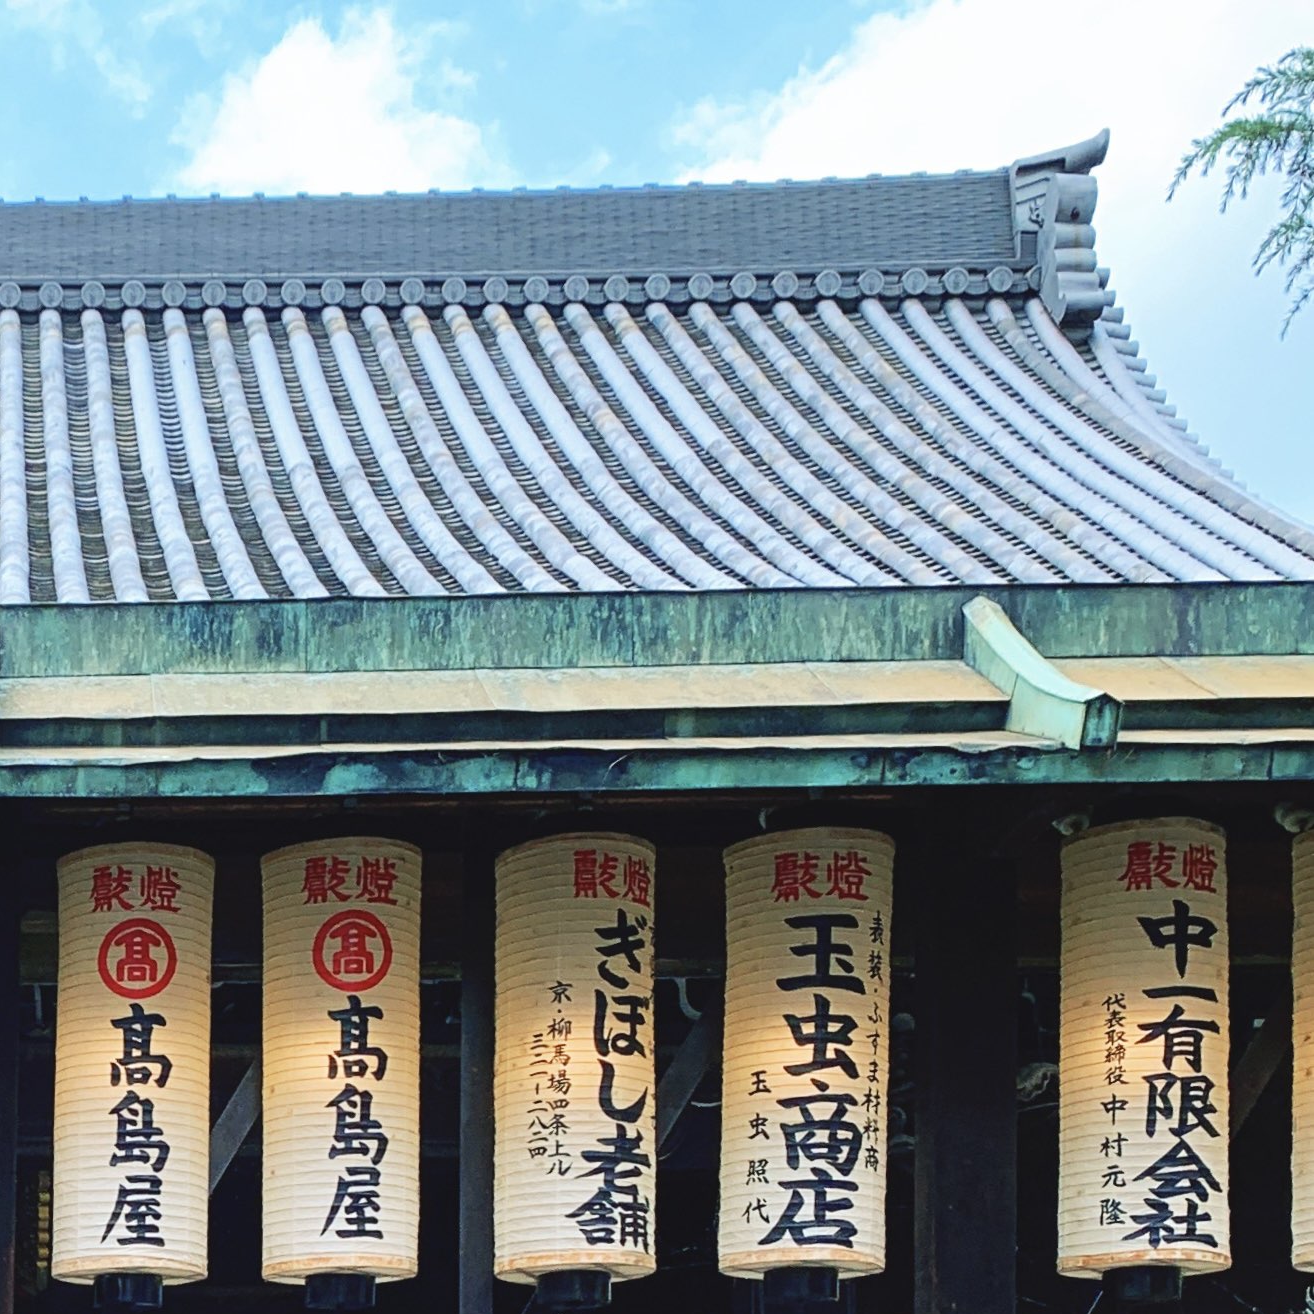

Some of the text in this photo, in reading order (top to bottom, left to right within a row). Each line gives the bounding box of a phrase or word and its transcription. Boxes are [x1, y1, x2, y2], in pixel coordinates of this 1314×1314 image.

[742, 1070, 772, 1224] 玉虫照代
[758, 913, 866, 1248] 玉虫商店
[1122, 899, 1223, 1249] 中一有限会社
